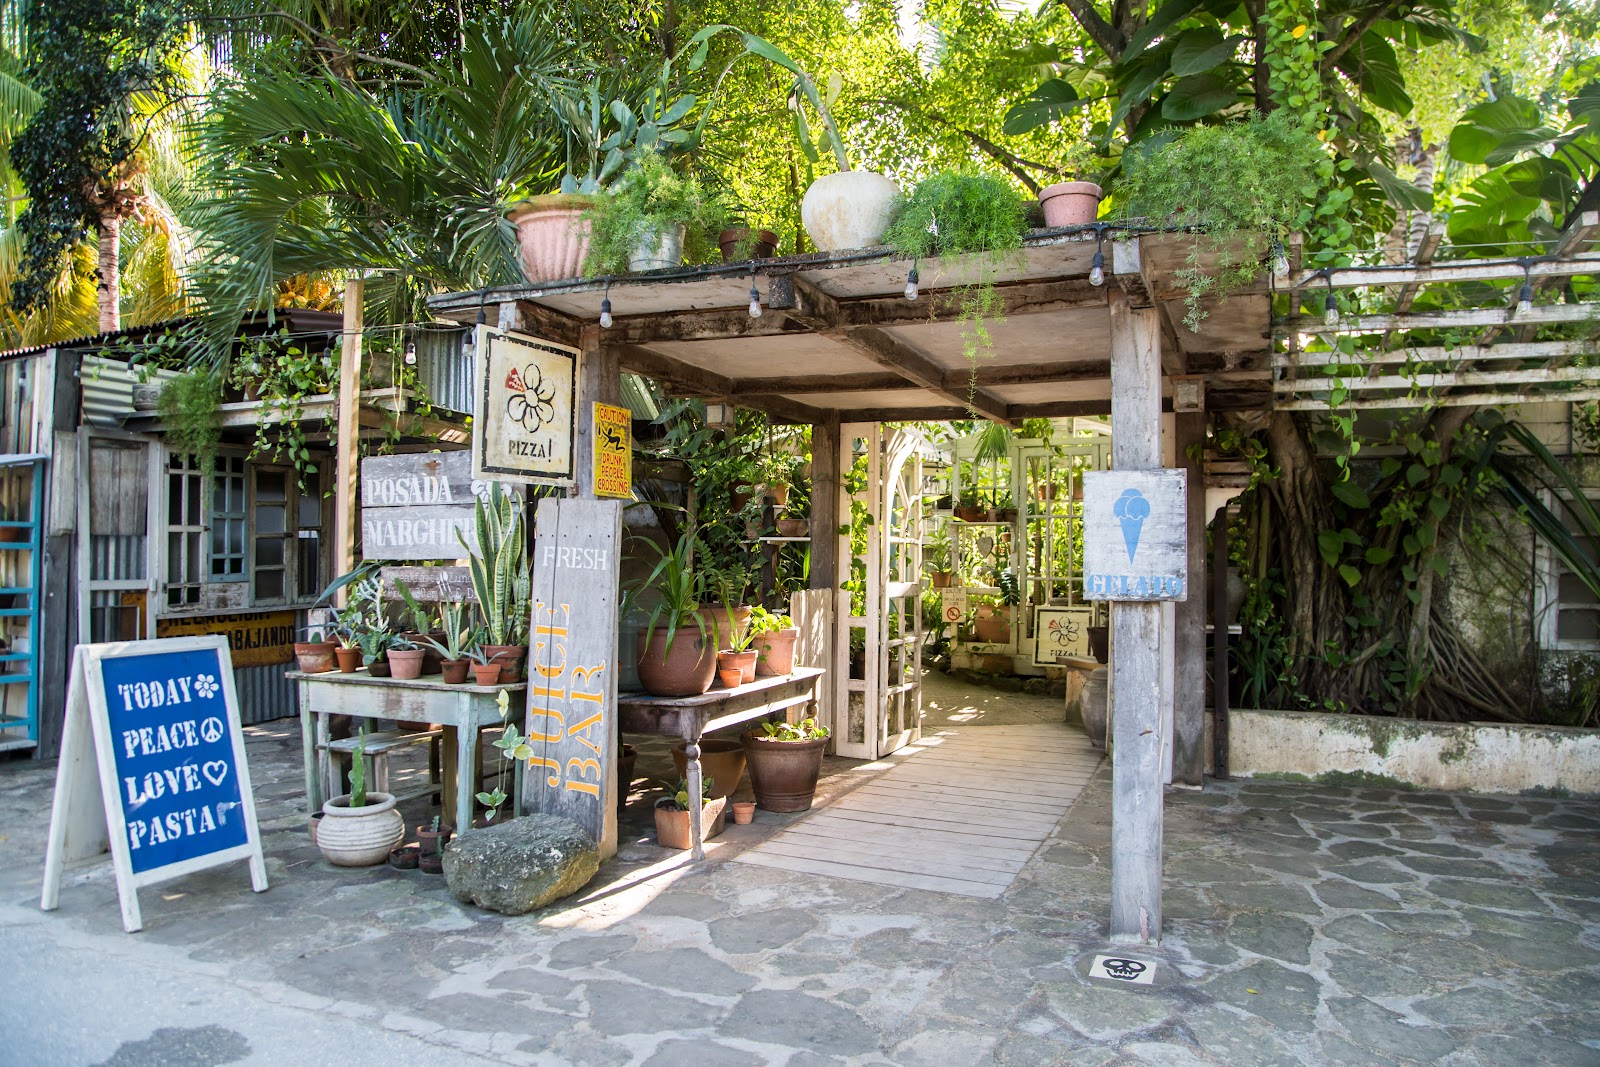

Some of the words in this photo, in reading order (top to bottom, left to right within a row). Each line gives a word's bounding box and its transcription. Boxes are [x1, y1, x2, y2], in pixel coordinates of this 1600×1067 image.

[599, 407, 627, 425] CAUTION
[508, 438, 552, 463] PIZZA!
[602, 452, 623, 467] DRUNK
[597, 478, 628, 494] CROSSING
[601, 465, 624, 479] PEOPLE
[366, 475, 453, 505] POSADA
[366, 517, 477, 547] MARGHER
[541, 546, 608, 571] FRESH
[1086, 574, 1184, 598] GELATO
[207, 625, 297, 651] ABAJANDO
[118, 676, 192, 711] TODAY
[527, 603, 570, 788] JUICE
[122, 720, 199, 759] PEACE
[565, 660, 606, 800] BAR
[124, 764, 202, 804] LOVE
[128, 805, 217, 850] PASTA
